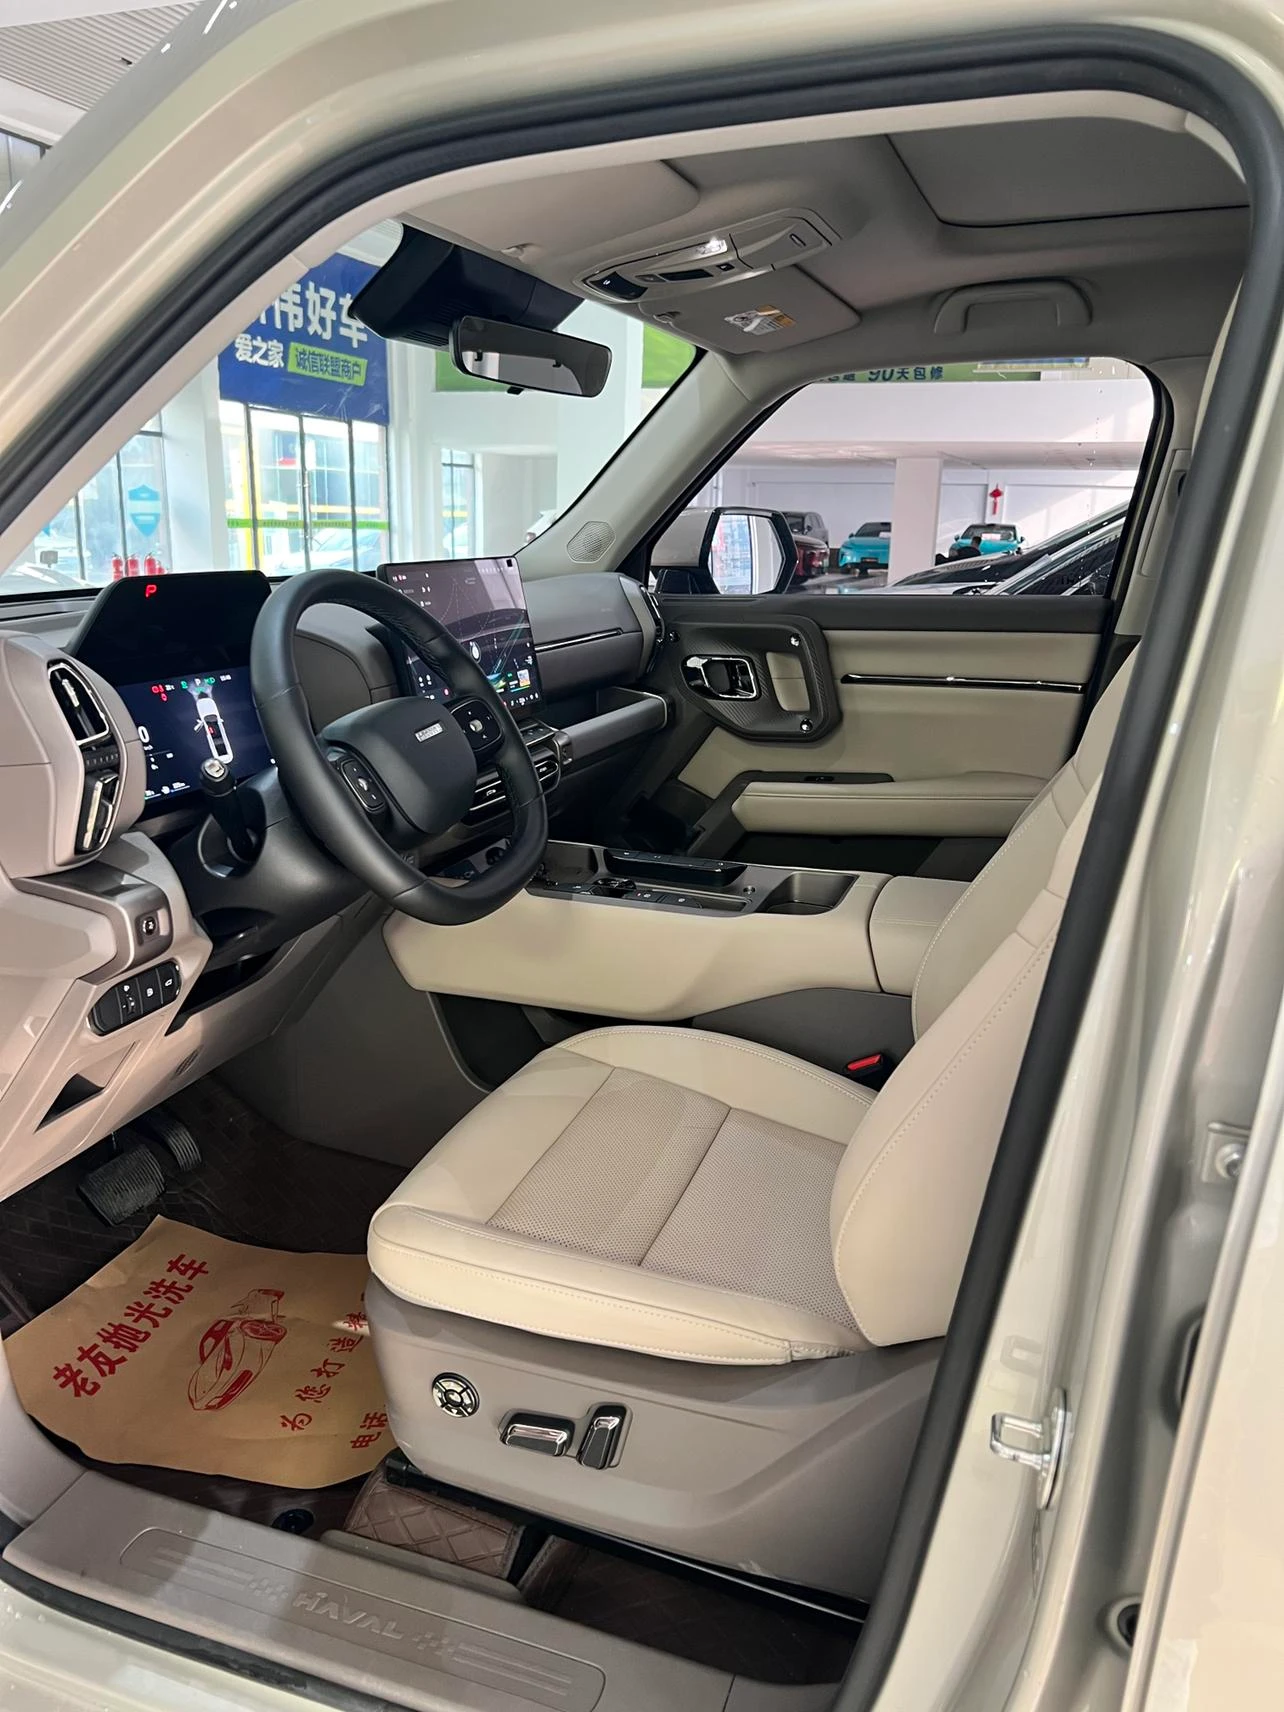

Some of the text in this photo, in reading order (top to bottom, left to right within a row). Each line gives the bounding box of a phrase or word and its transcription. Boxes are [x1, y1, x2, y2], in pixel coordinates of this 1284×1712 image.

[259, 281, 368, 349] 伟好车
[234, 333, 285, 369] 爱之家
[295, 348, 362, 381] 诚信联盟商户
[145, 584, 157, 597] P
[53, 1253, 209, 1398] 老友抛光洗车
[350, 1411, 388, 1449] 电话
[293, 1592, 404, 1640] HAVAL
